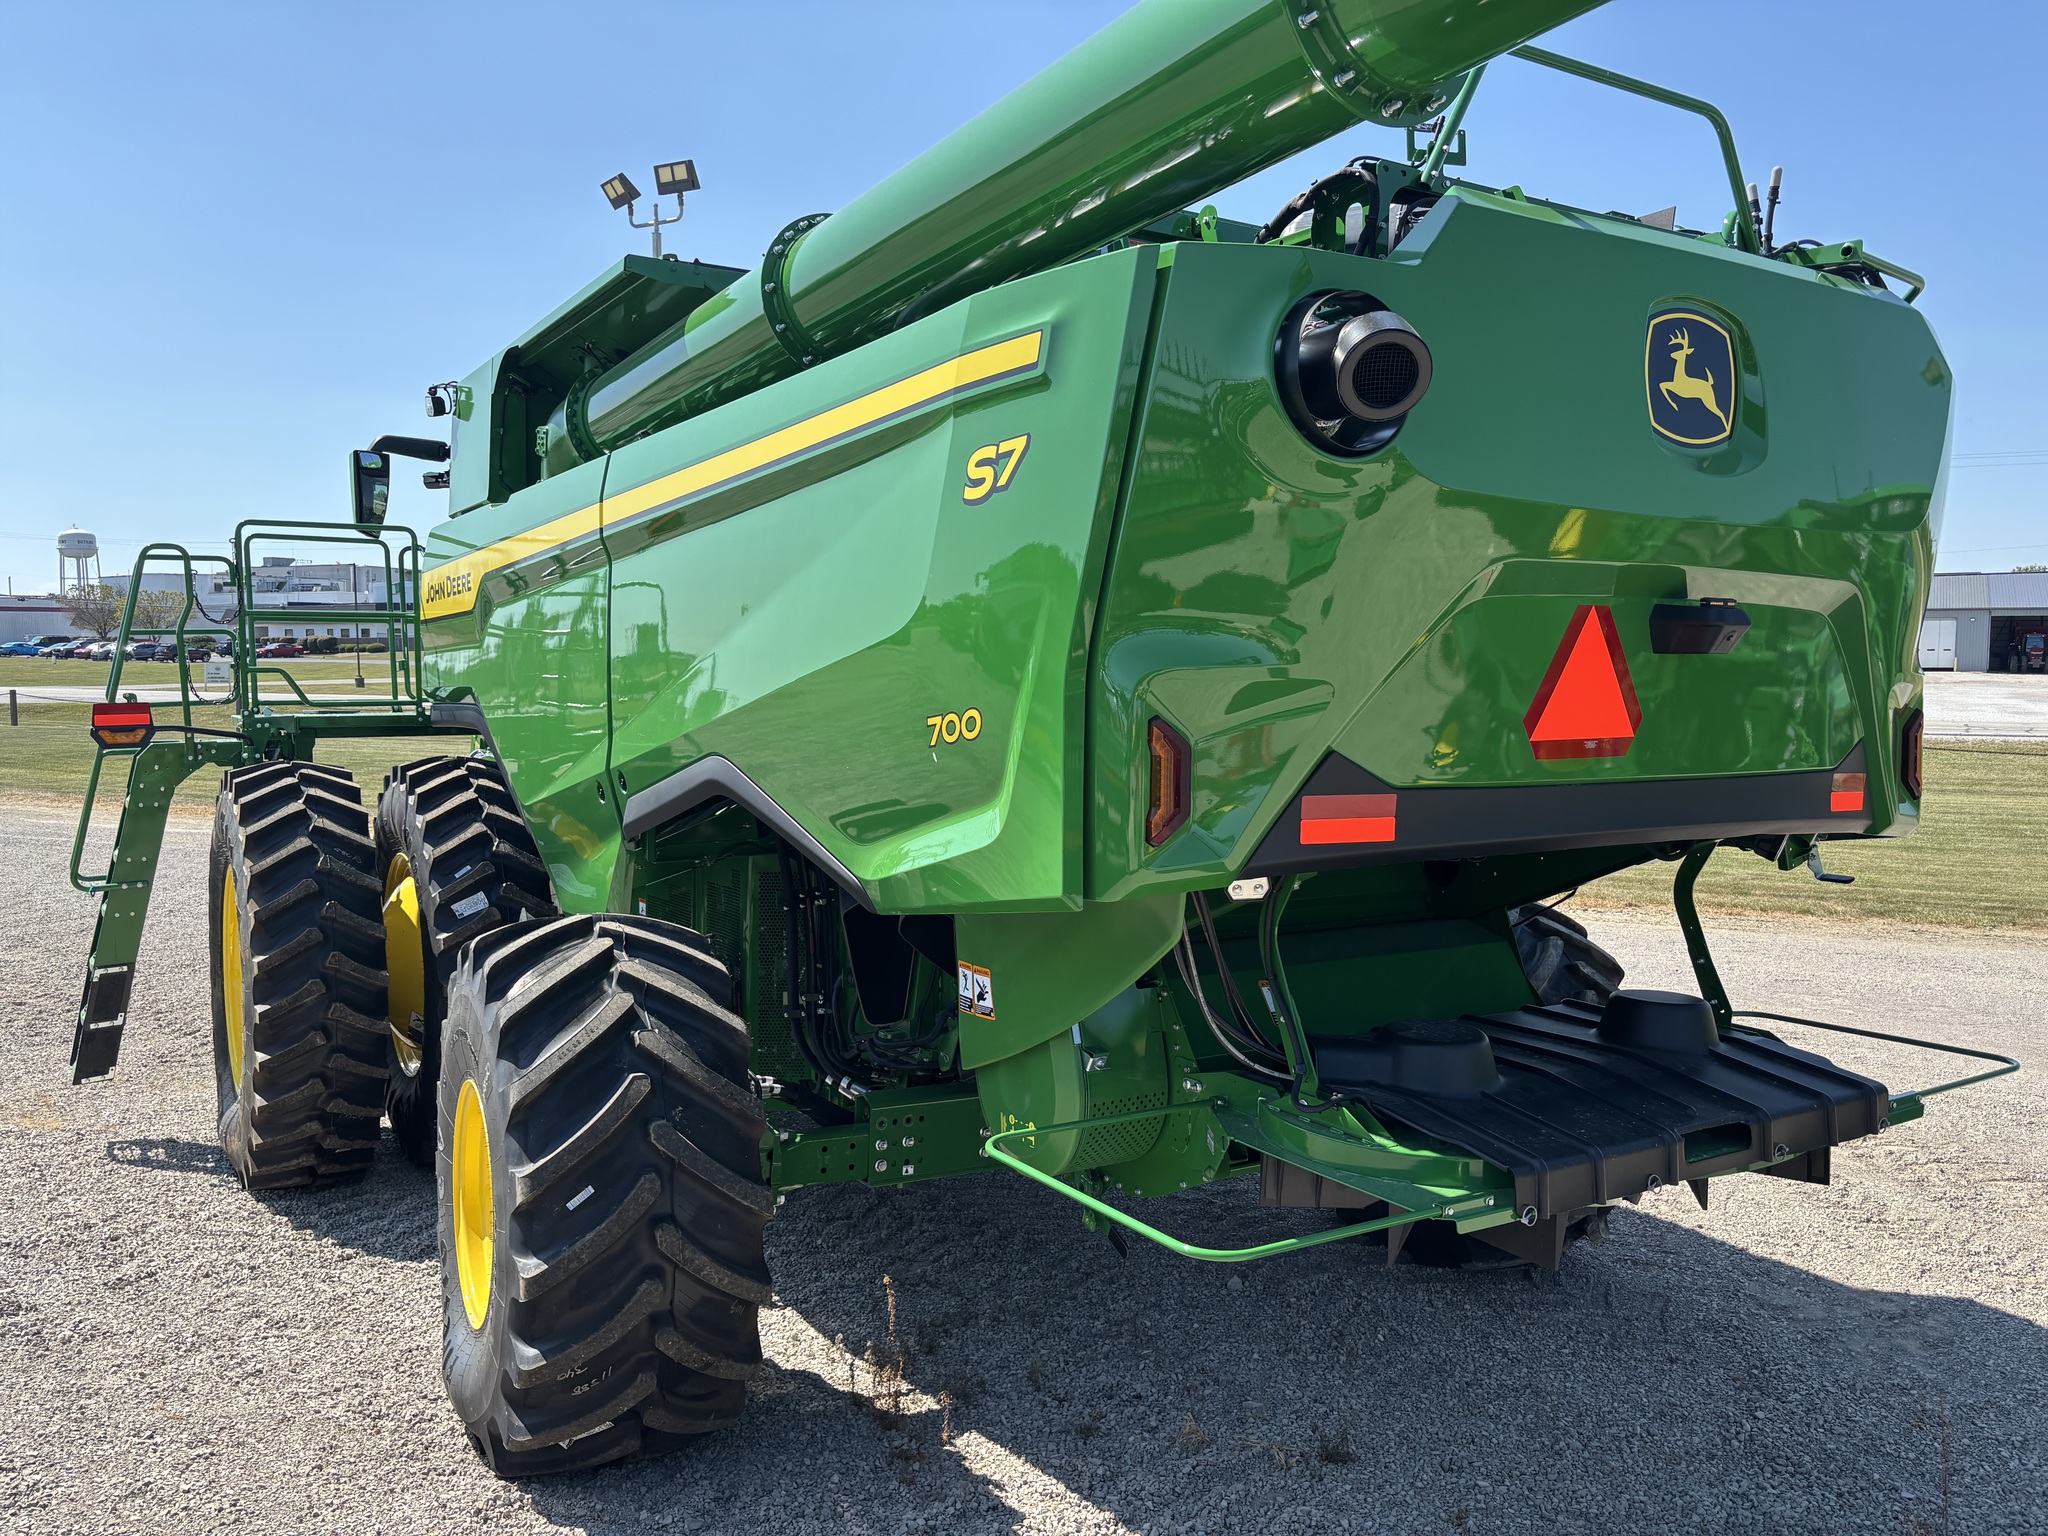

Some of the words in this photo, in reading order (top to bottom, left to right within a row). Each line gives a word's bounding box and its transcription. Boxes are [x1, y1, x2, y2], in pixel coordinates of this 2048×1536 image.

[962, 432, 1031, 507] S7
[426, 582, 446, 604] JOHN
[446, 572, 472, 598] DEERE
[926, 706, 982, 748] 700
